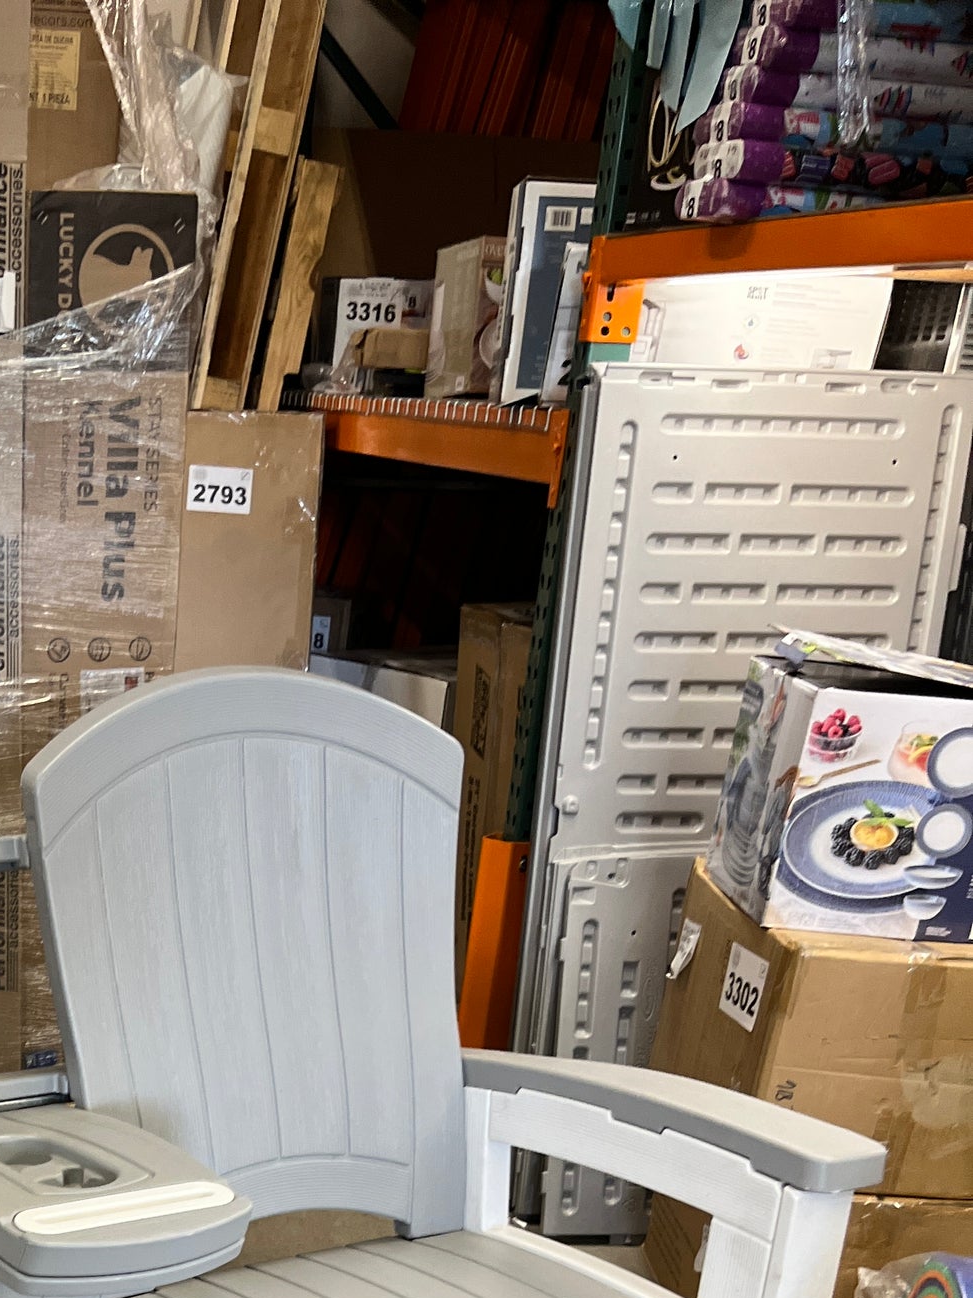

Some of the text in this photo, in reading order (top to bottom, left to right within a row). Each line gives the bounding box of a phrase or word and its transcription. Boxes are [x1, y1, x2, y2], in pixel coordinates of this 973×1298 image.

[57, 211, 75, 289] LUCKY
[345, 301, 397, 324] 3316
[77, 401, 104, 507] Kennel
[143, 446, 161, 513] SERIES
[101, 396, 142, 603] Villa Plus
[192, 483, 247, 507] 2793
[725, 970, 759, 1018] 3302
